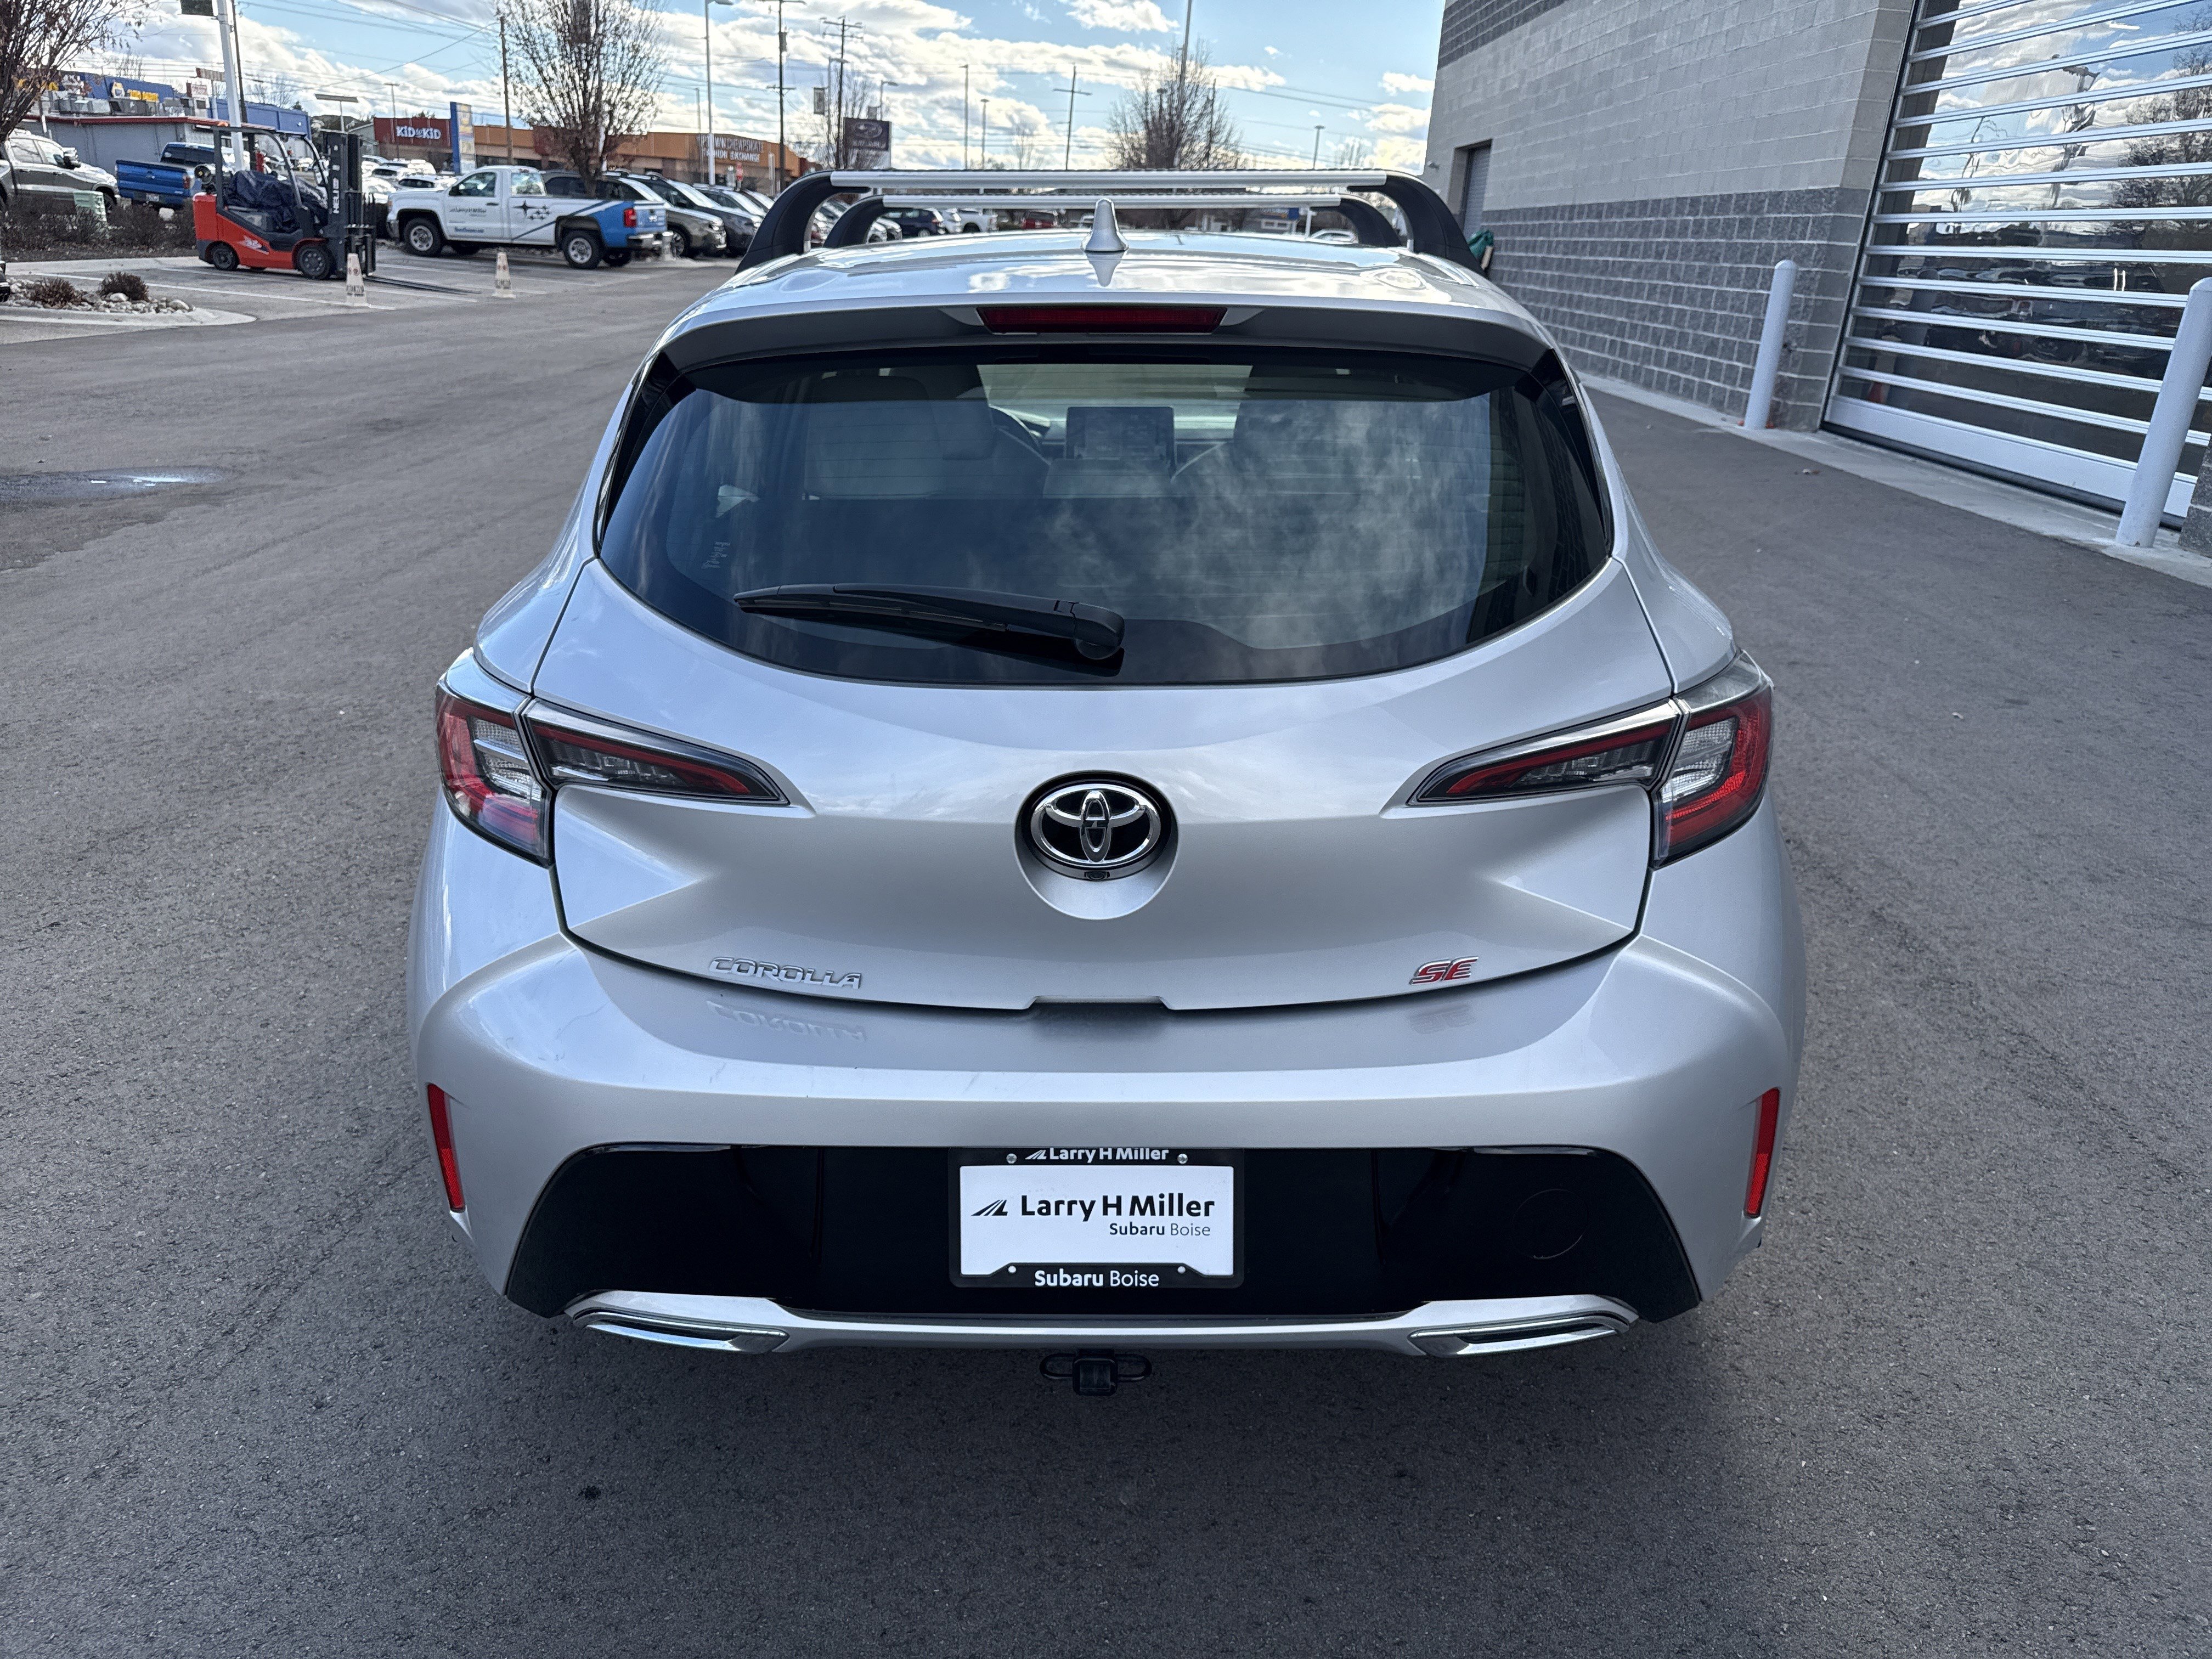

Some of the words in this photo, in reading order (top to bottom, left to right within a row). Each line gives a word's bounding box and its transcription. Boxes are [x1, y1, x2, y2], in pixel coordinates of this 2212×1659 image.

[708, 956, 862, 989] COROLLA
[1409, 956, 1479, 985] SE
[1049, 1147, 1096, 1163] Larry
[1099, 1148, 1113, 1160] H
[1116, 1148, 1169, 1160] Miller
[1021, 1195, 1096, 1222] Larry
[1102, 1195, 1122, 1216] H
[1129, 1193, 1215, 1217] Miller
[1109, 1222, 1165, 1235] Subaru
[1170, 1223, 1211, 1236] Boise
[1035, 1268, 1104, 1287] Subaru
[1110, 1270, 1159, 1287] Boise
